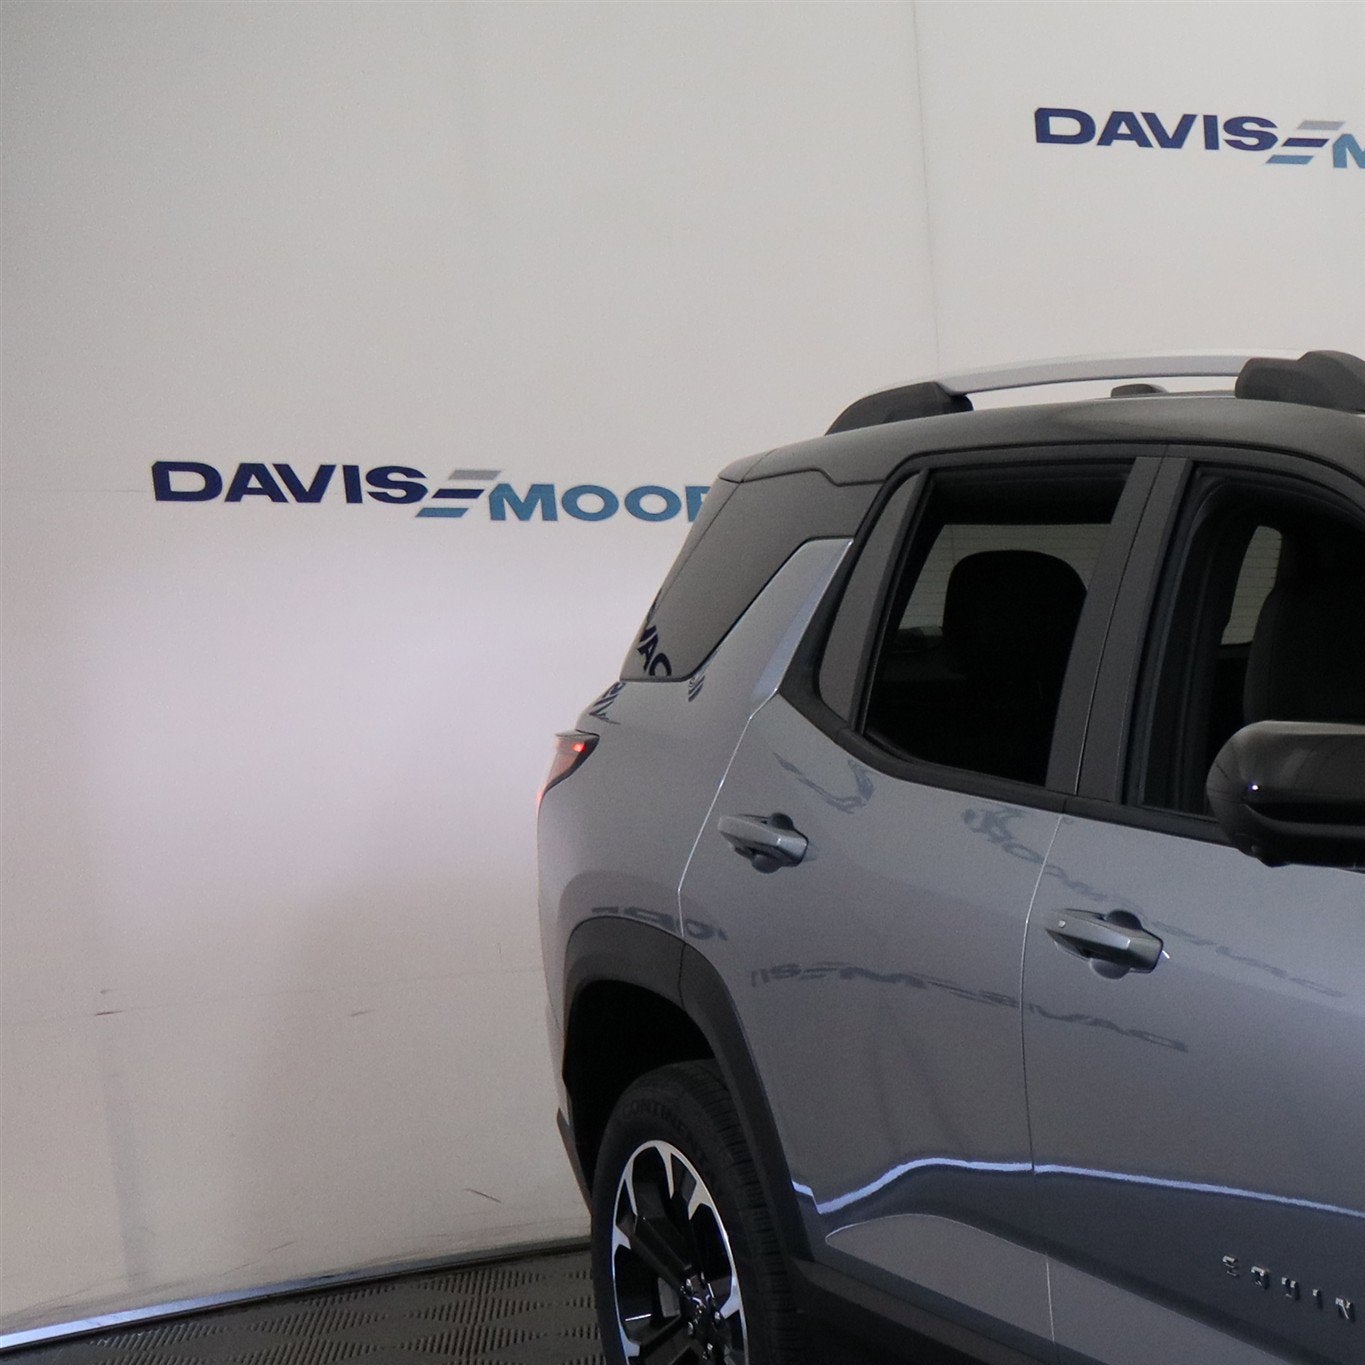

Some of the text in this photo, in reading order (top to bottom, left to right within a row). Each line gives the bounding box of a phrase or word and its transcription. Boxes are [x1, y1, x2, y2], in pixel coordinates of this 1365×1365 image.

[1033, 106, 1279, 152] DAVIS
[150, 459, 712, 523] DAVIS MOO
